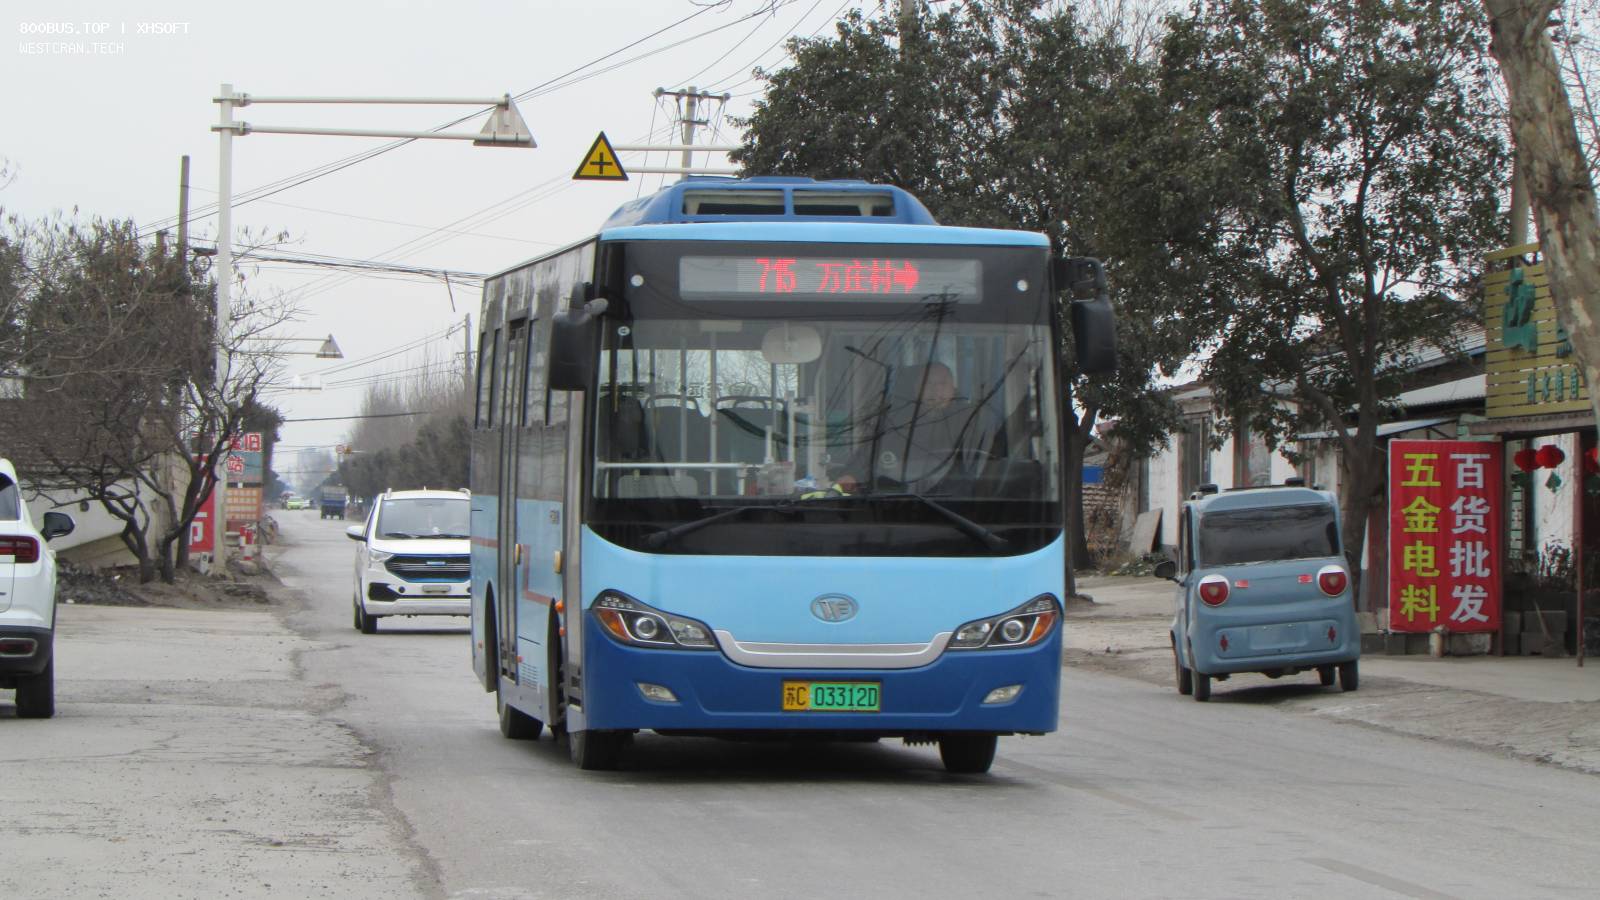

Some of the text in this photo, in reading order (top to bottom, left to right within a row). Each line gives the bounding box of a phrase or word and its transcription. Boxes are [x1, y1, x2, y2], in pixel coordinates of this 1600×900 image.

[755, 258, 895, 294] 715 万庄村
[1401, 452, 1441, 622] 五金电料
[1449, 453, 1490, 623] 百货批发
[814, 686, 878, 707] 03312D
